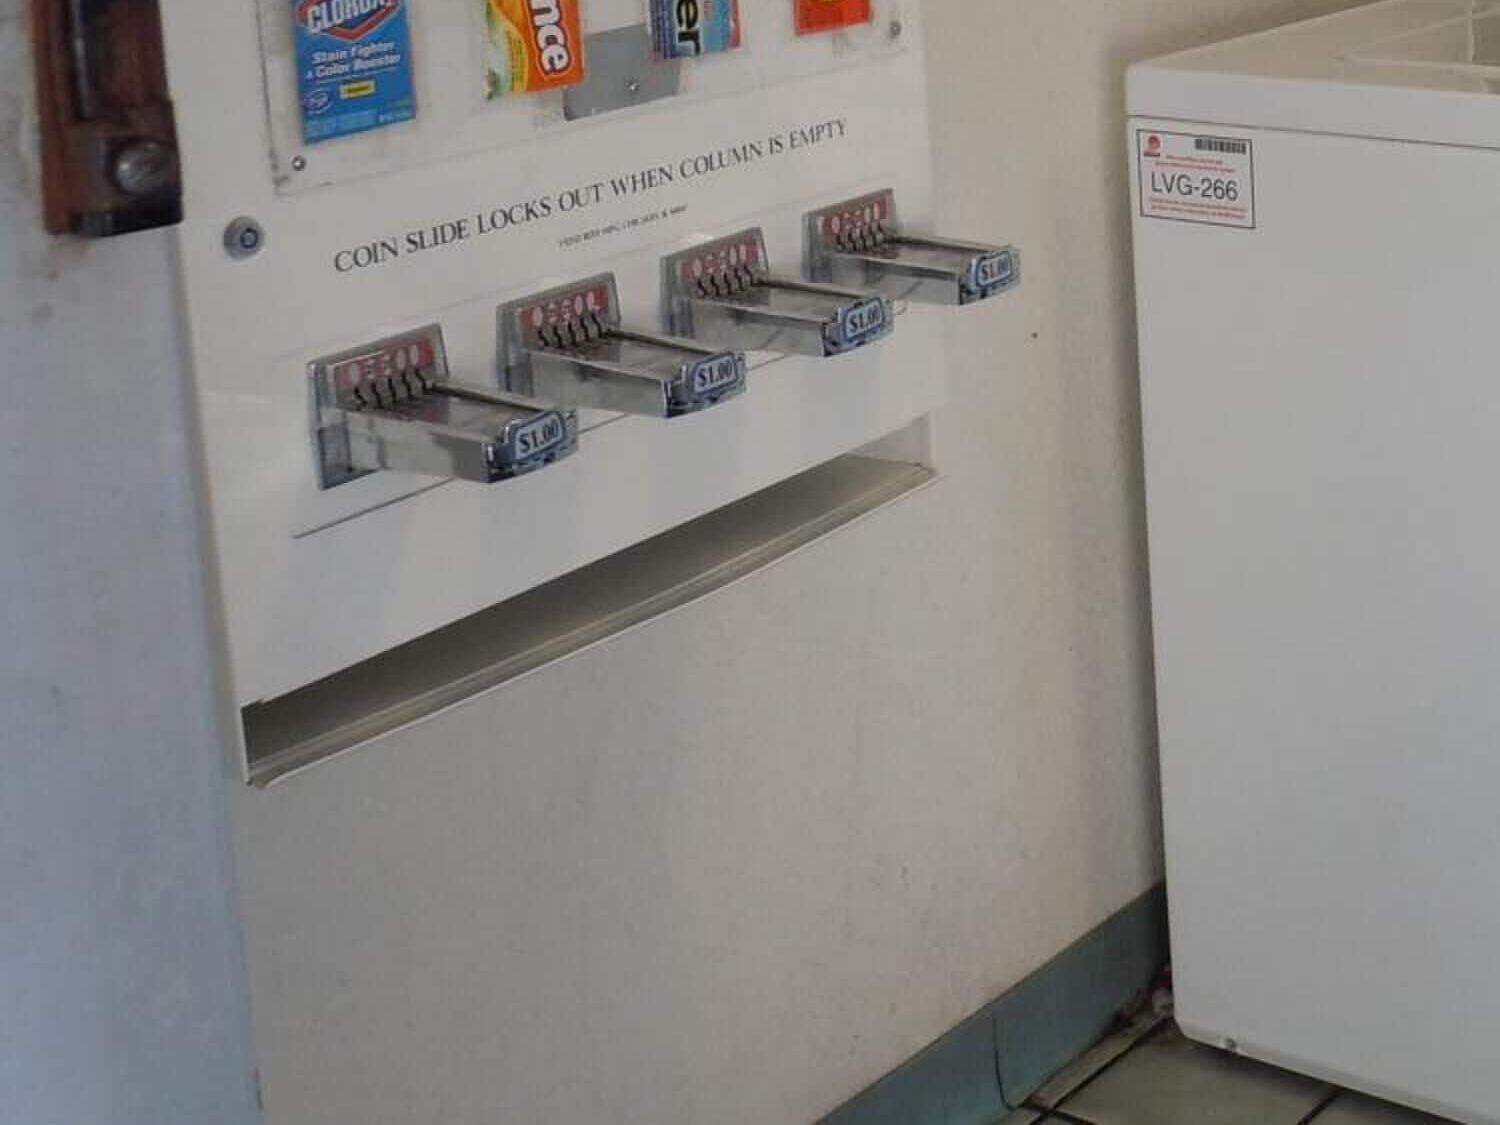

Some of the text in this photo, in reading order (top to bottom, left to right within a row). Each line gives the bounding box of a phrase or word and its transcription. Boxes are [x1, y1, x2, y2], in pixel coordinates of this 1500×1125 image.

[334, 237, 399, 273] COIN
[405, 218, 471, 254] SLIDE
[476, 196, 552, 236] LOCKS
[558, 182, 605, 212] OUT
[610, 164, 675, 196] WHEN
[679, 141, 764, 179] COLUMN
[768, 133, 785, 155] IS
[788, 119, 849, 149] EMPTY
[1151, 170, 1239, 202] LVG-266
[698, 355, 733, 388] $1.00
[518, 416, 561, 454] $1.00
